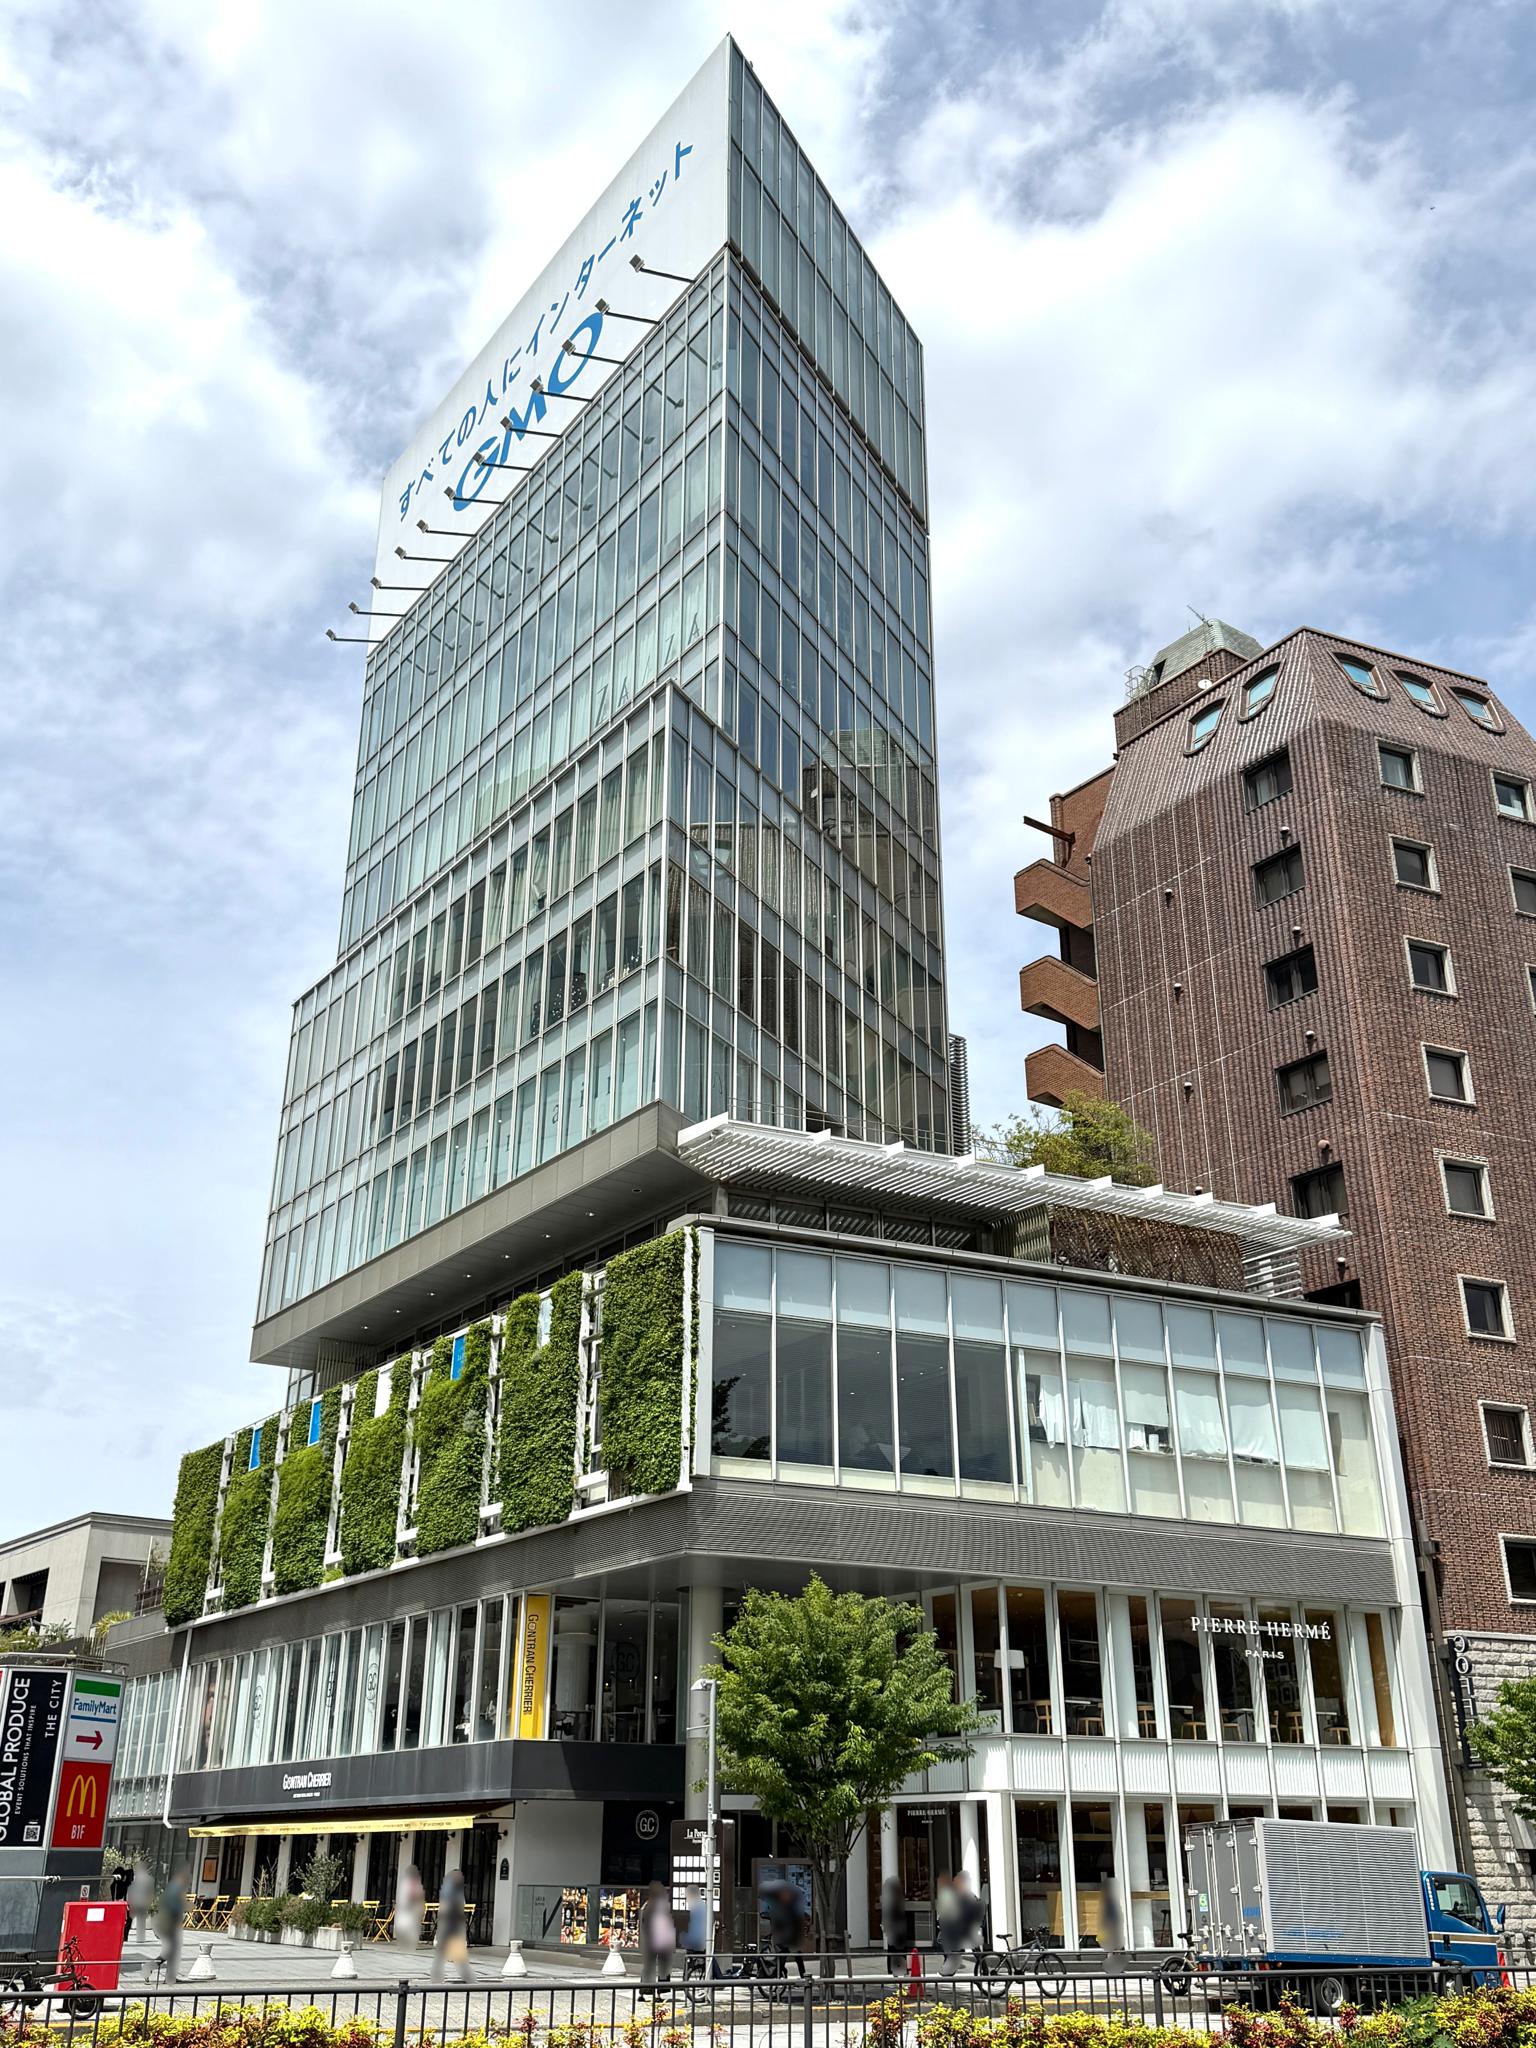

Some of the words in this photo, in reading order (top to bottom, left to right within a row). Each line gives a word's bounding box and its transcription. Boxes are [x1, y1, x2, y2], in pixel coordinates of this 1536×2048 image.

[400, 141, 693, 522] すべての人にインターネット
[453, 311, 604, 511] GMO
[526, 1614, 539, 1664] GONTRAN
[1190, 1616, 1260, 1635] PIERRE
[1266, 1621, 1331, 1640] HERMÉ
[1245, 1649, 1284, 1660] PARIS
[49, 1680, 62, 1708] CITY
[523, 1665, 537, 1715] CHERRIER
[27, 1705, 37, 1731] INSPIRE
[73, 1698, 117, 1716] FamilyMart
[3, 1678, 31, 1763] PRODUCE
[44, 1714, 58, 1738] THE
[23, 1733, 32, 1750] THAT
[18, 1752, 30, 1791] SOLUTIONS
[14, 1793, 24, 1815] EVENT
[71, 1824, 86, 1840] B1F
